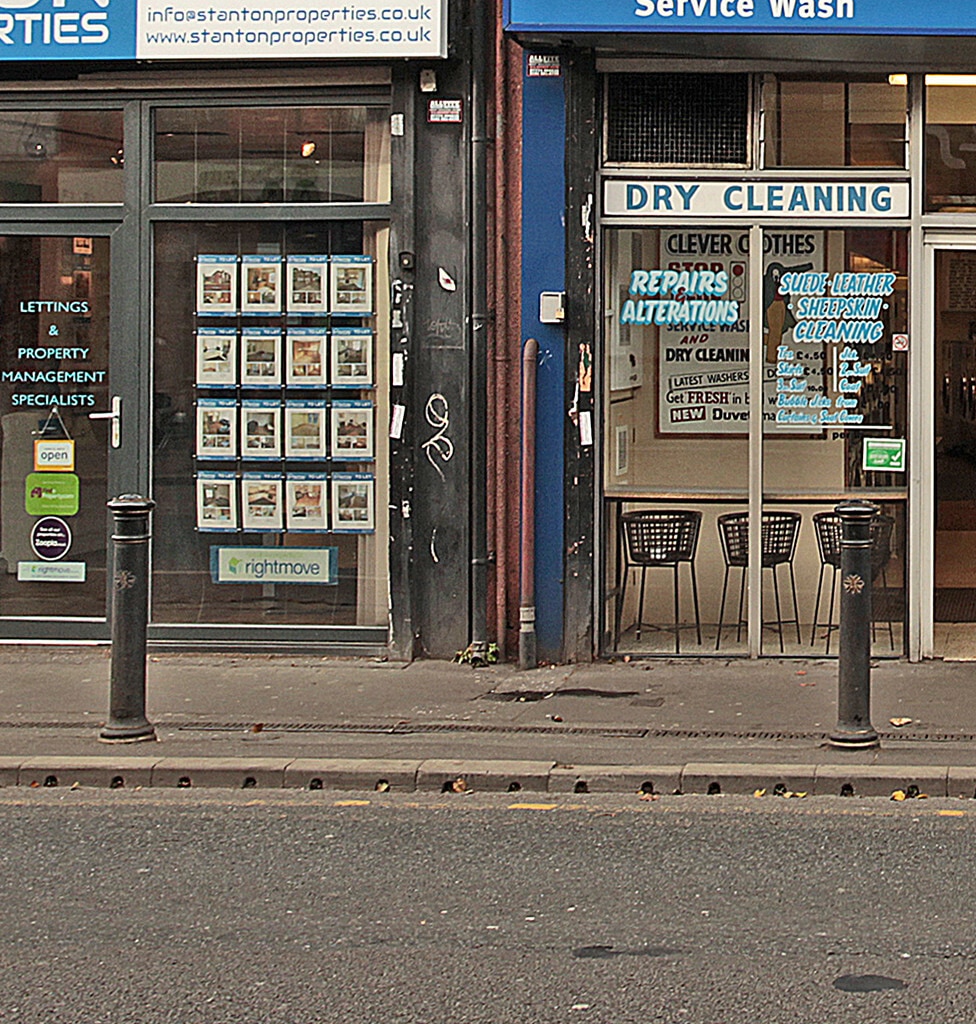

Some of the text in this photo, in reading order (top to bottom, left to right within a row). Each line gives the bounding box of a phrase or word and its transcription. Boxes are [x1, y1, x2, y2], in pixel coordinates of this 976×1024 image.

[147, 5, 431, 24] info@stantonproperties.co.uk
[0, 12, 110, 45] RTIES
[146, 27, 432, 46] www.stantonproperties.co.uk
[626, 184, 893, 212] DRY CLEANING
[667, 234, 815, 255] CLEVER COTHES
[629, 270, 729, 297] REPAIRS
[778, 273, 897, 296] SUEDE LEATHER
[19, 301, 89, 314] LETTINGS
[620, 300, 739, 325] ALTERATIONS
[795, 297, 882, 320] SHEEPSKIN
[48, 325, 59, 337] &
[680, 333, 709, 345] AND
[793, 321, 884, 344] CLEANING
[17, 347, 90, 360] PROPERTY
[666, 348, 750, 362] DRY CLEANIN
[1, 370, 106, 383] MANAGEMENT
[674, 371, 750, 387] LATEST WASHERS
[11, 393, 95, 406] SPECIALISTS
[666, 391, 684, 404] Get
[733, 393, 742, 404] in
[672, 407, 704, 421] NEW
[40, 450, 68, 462] open
[246, 559, 320, 578] rightmove
